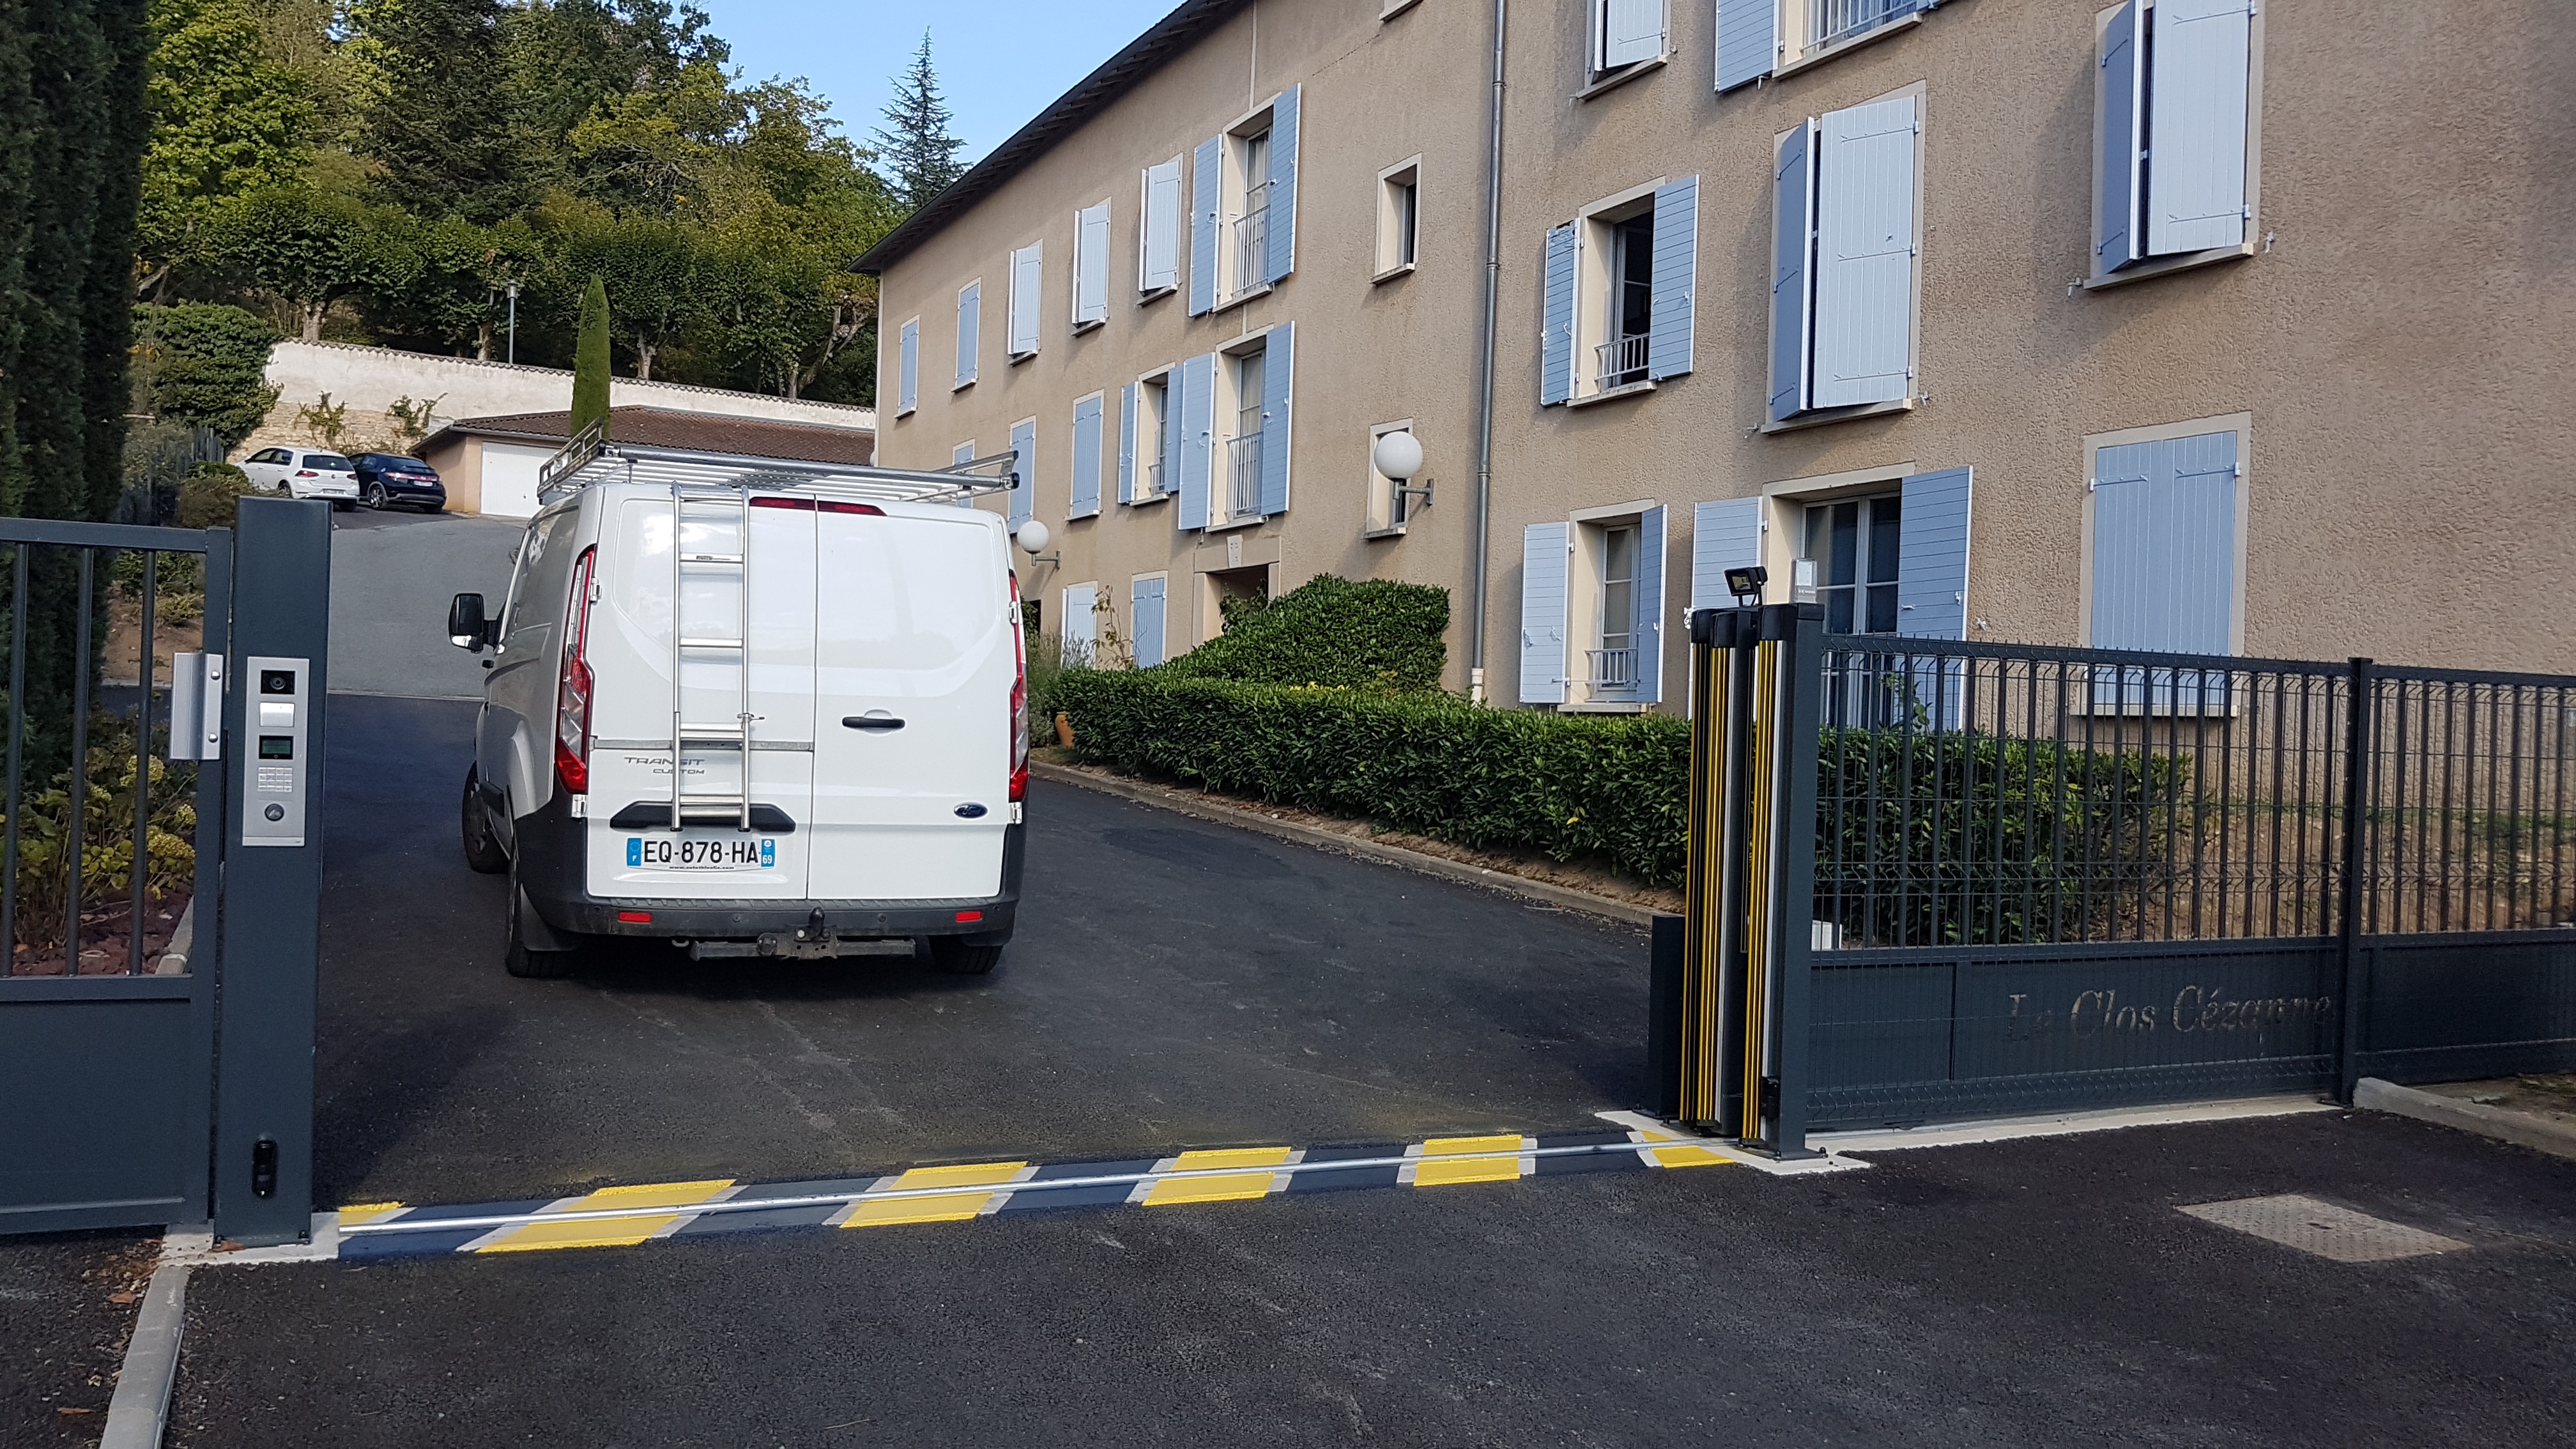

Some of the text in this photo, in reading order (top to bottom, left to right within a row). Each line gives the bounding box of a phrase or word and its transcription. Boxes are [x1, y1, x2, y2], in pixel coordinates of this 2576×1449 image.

[624, 757, 705, 765] TRANSIT
[644, 841, 758, 863] EQ-878-HA
[762, 854, 772, 864] 69
[2070, 990, 2157, 1039] Clos
